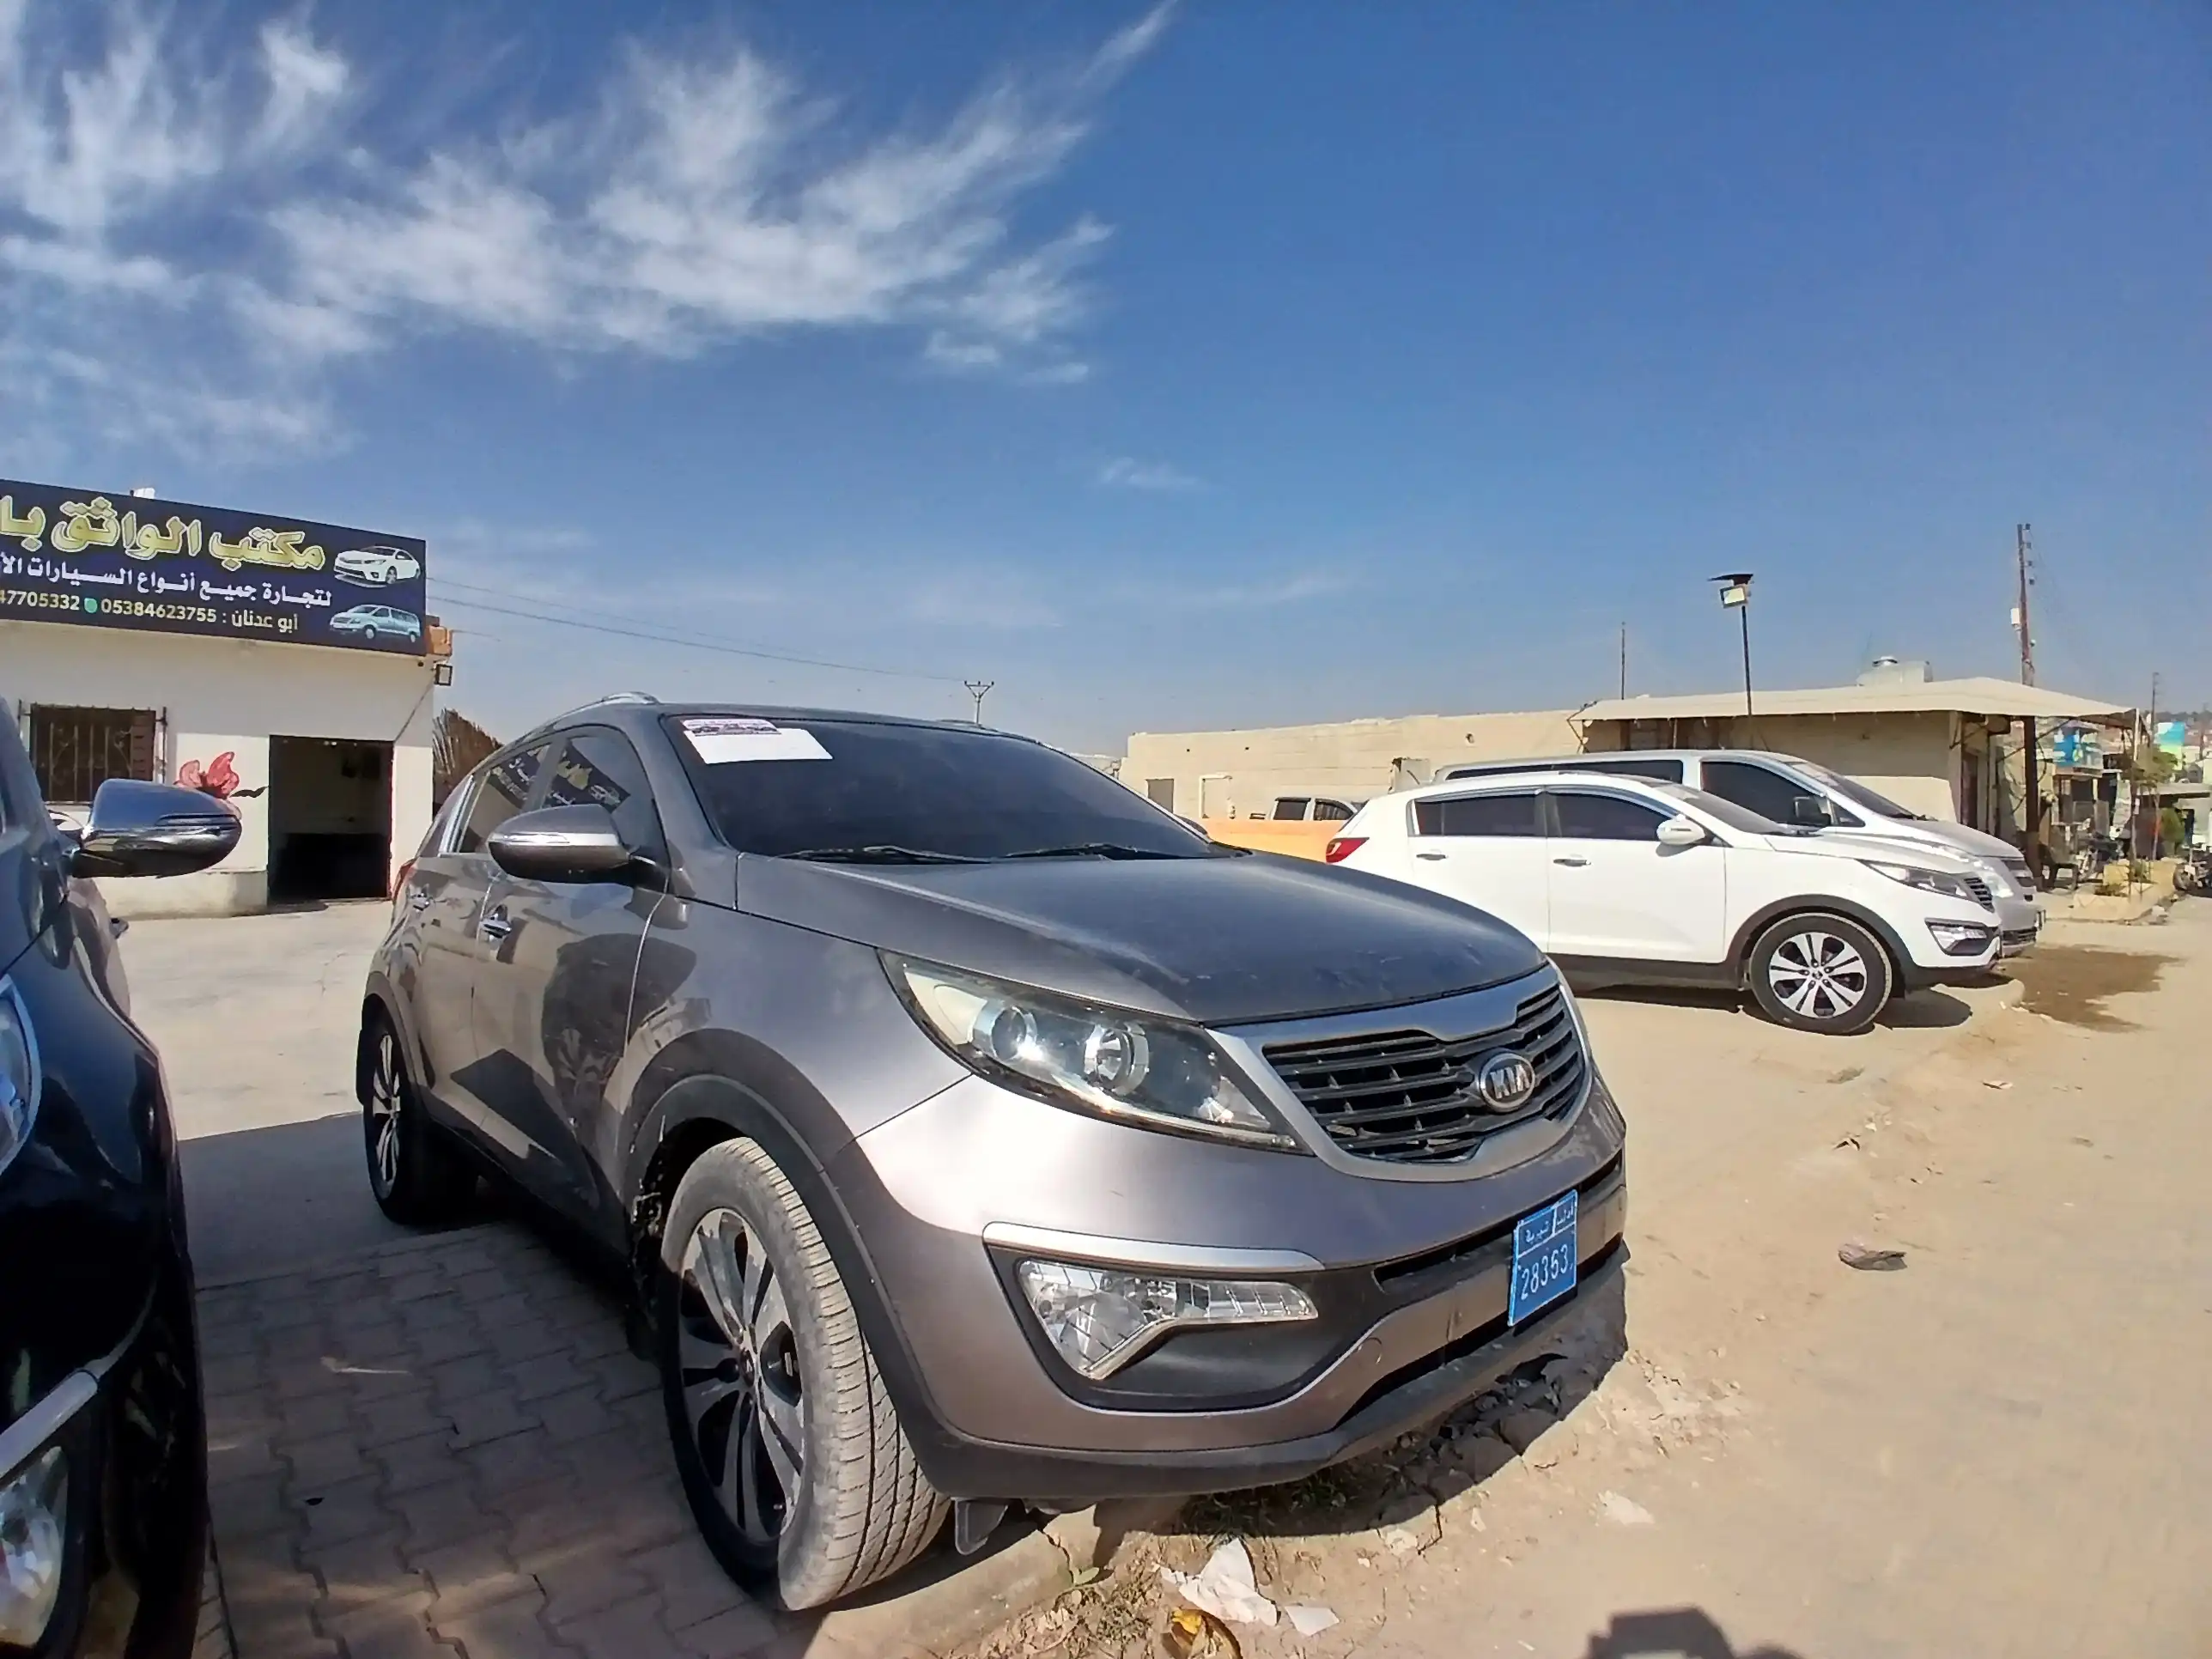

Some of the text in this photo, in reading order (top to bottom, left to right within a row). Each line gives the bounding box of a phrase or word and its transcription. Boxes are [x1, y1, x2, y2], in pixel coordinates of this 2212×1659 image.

[51, 496, 202, 560] الواثق
[209, 526, 326, 572] مكتب
[27, 557, 133, 586] السيارات
[137, 572, 195, 594] أنواع
[199, 580, 258, 601] جميع
[262, 581, 332, 609] لتجارة
[100, 598, 217, 623] 05384623755
[231, 609, 273, 629] عدنان
[277, 612, 299, 634] أبو
[1490, 1064, 1530, 1099] KIA
